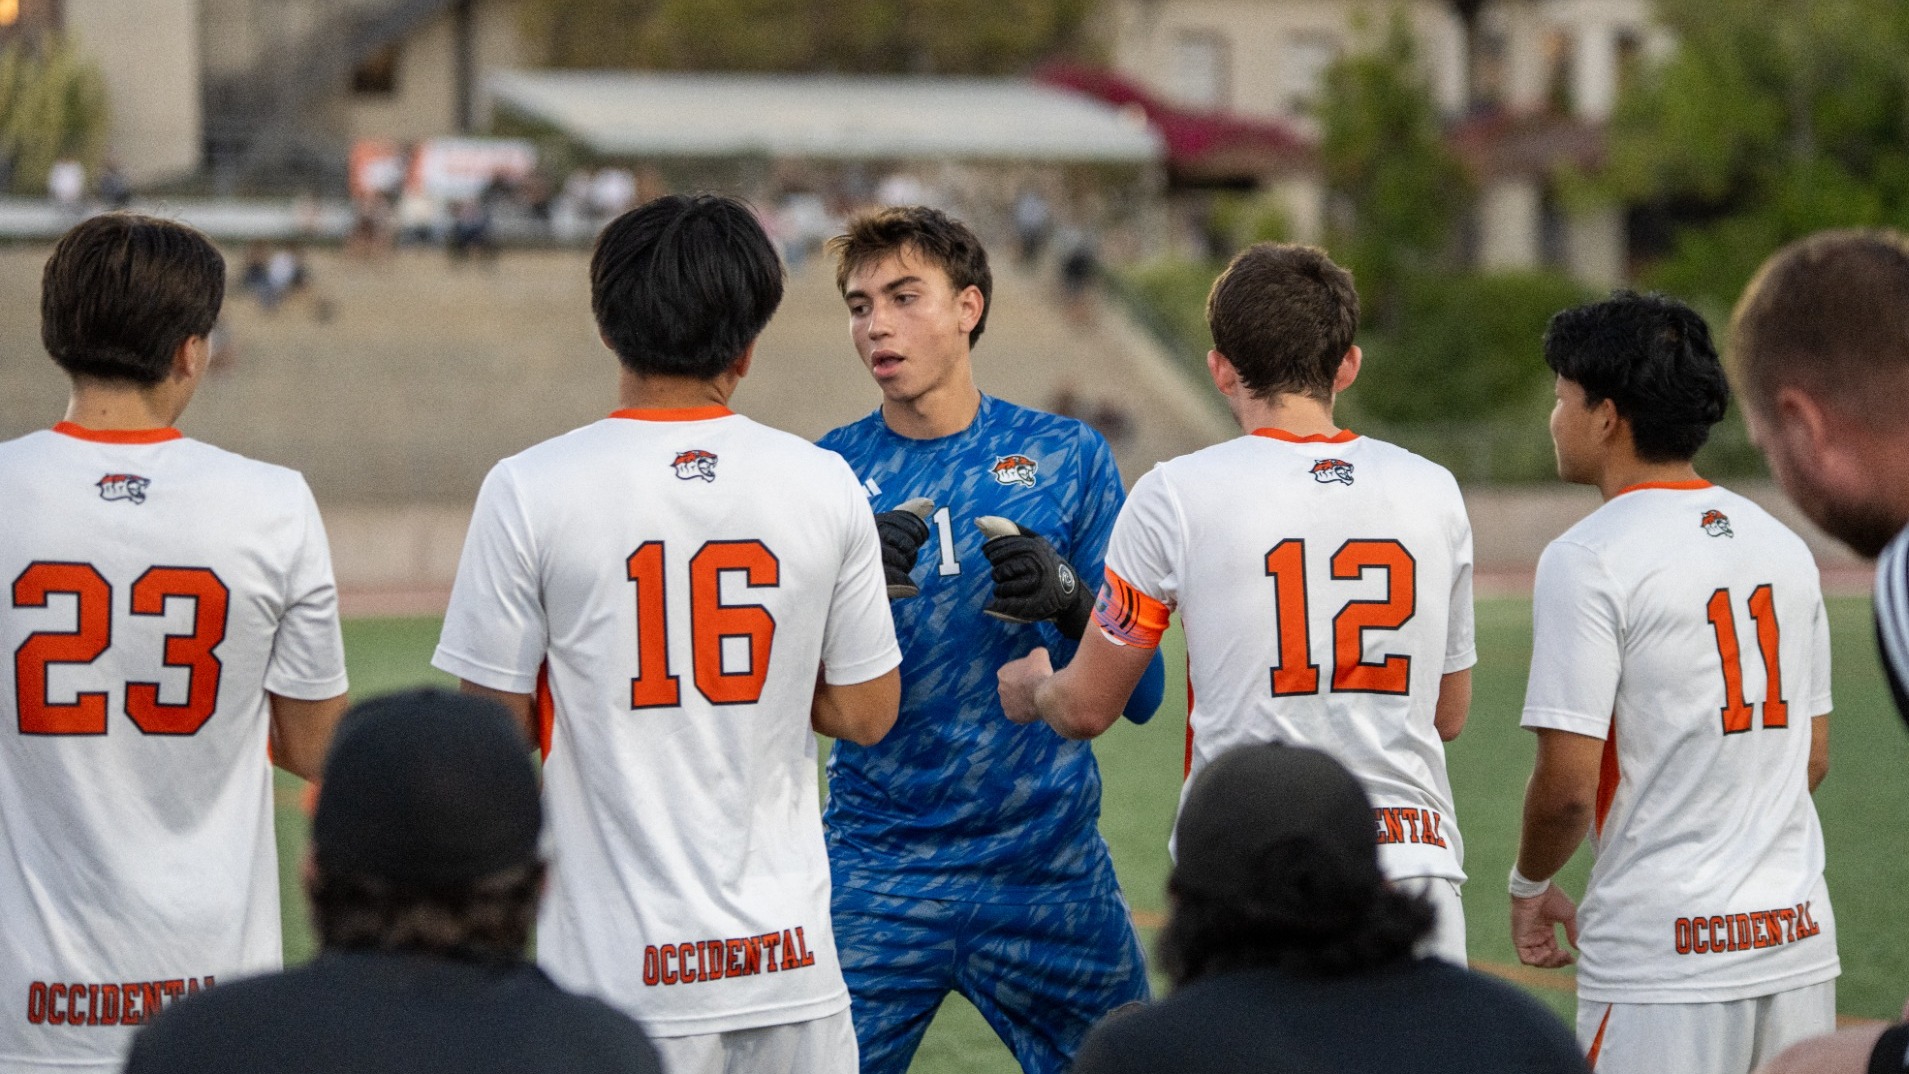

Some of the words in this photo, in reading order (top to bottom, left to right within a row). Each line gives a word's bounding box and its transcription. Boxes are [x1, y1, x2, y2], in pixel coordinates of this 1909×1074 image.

[932, 506, 961, 576] 1
[11, 561, 230, 736] 23
[626, 539, 780, 710] 16
[1265, 538, 1417, 698] 12
[1706, 583, 1789, 736] 11
[1371, 807, 1447, 850] ENTAL
[643, 926, 816, 987] OCCIDENTAL
[1675, 900, 1821, 955] OCCIDENTAL
[27, 975, 216, 1026] OCCIDENT
